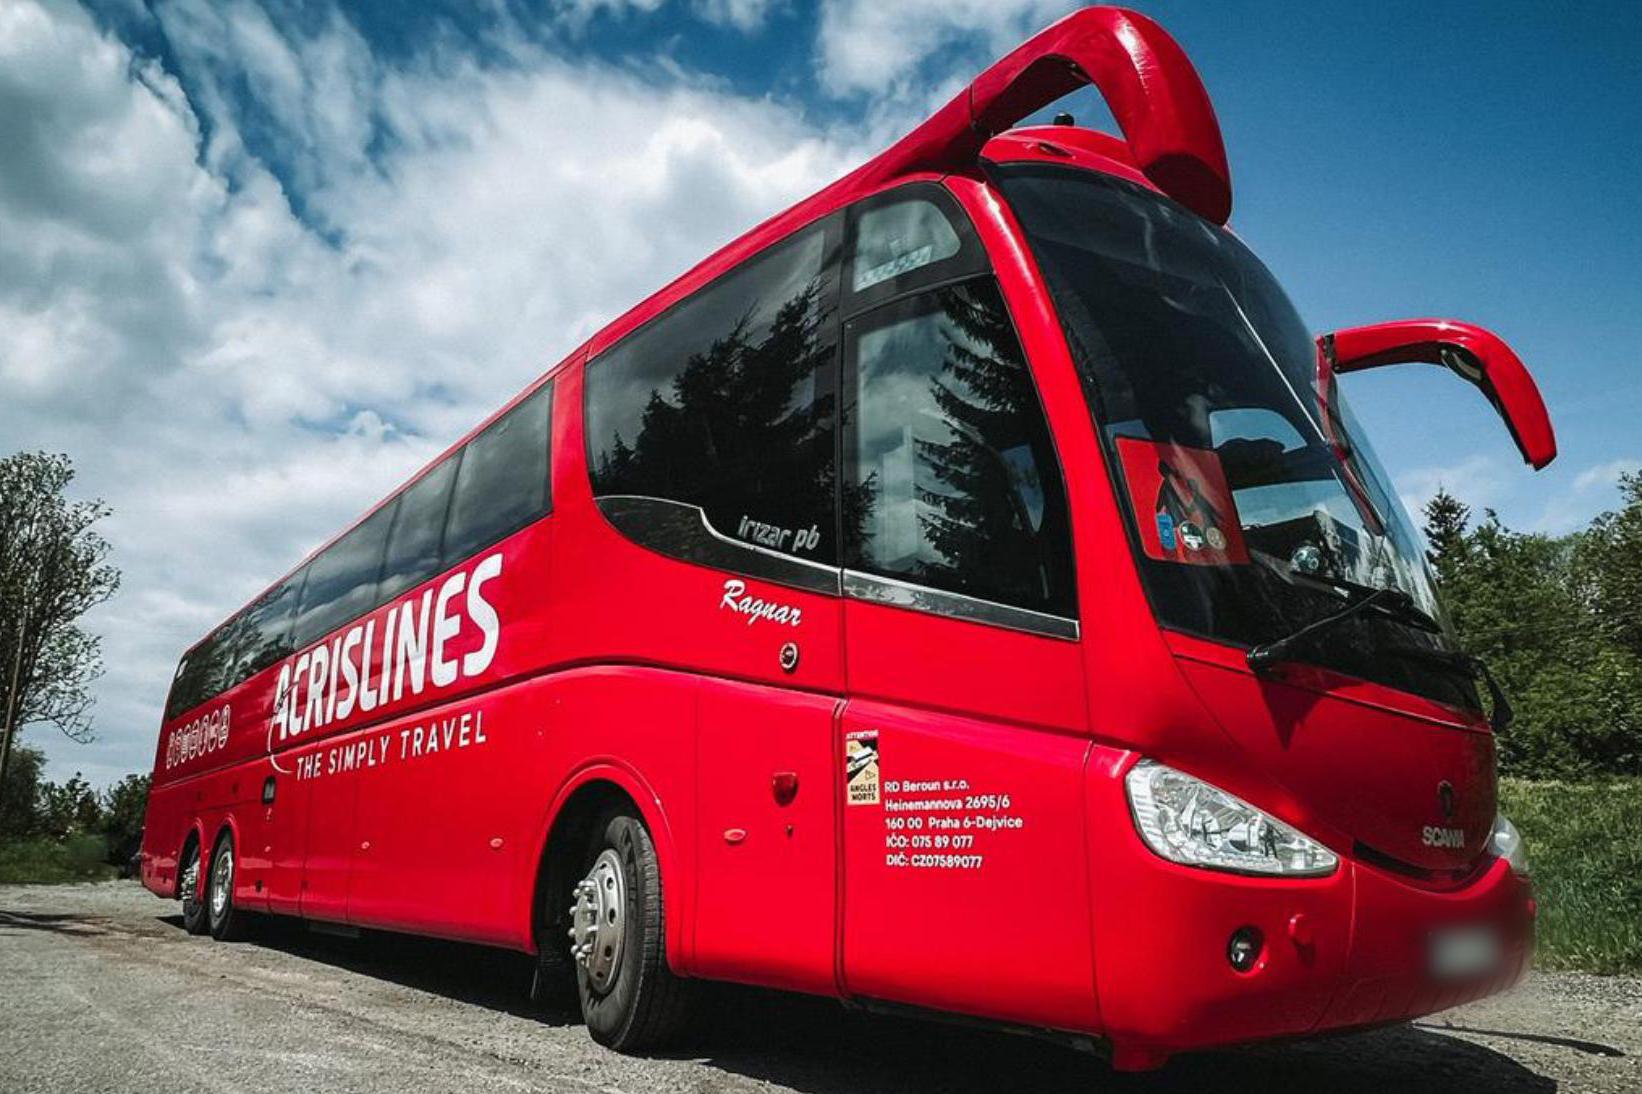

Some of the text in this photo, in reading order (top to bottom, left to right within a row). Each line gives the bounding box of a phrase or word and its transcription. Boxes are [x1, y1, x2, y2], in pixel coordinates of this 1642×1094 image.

[738, 515, 820, 552] irizar pb
[720, 579, 802, 627] Ragnar
[296, 710, 486, 780] THE SIMPLY TRAVEL
[850, 784, 876, 792] ANGLES
[884, 780, 970, 792] RD Beroun s.r.o.
[852, 793, 876, 801] MORTS
[884, 795, 1010, 811] Heinemannova 2695/6
[885, 815, 1023, 831] 160 00 Praha 6-Dejvice
[886, 834, 974, 848] IČO: 075 89 077
[1422, 826, 1465, 848] SCANIA
[886, 853, 982, 868] DIČ: CZ07589077
